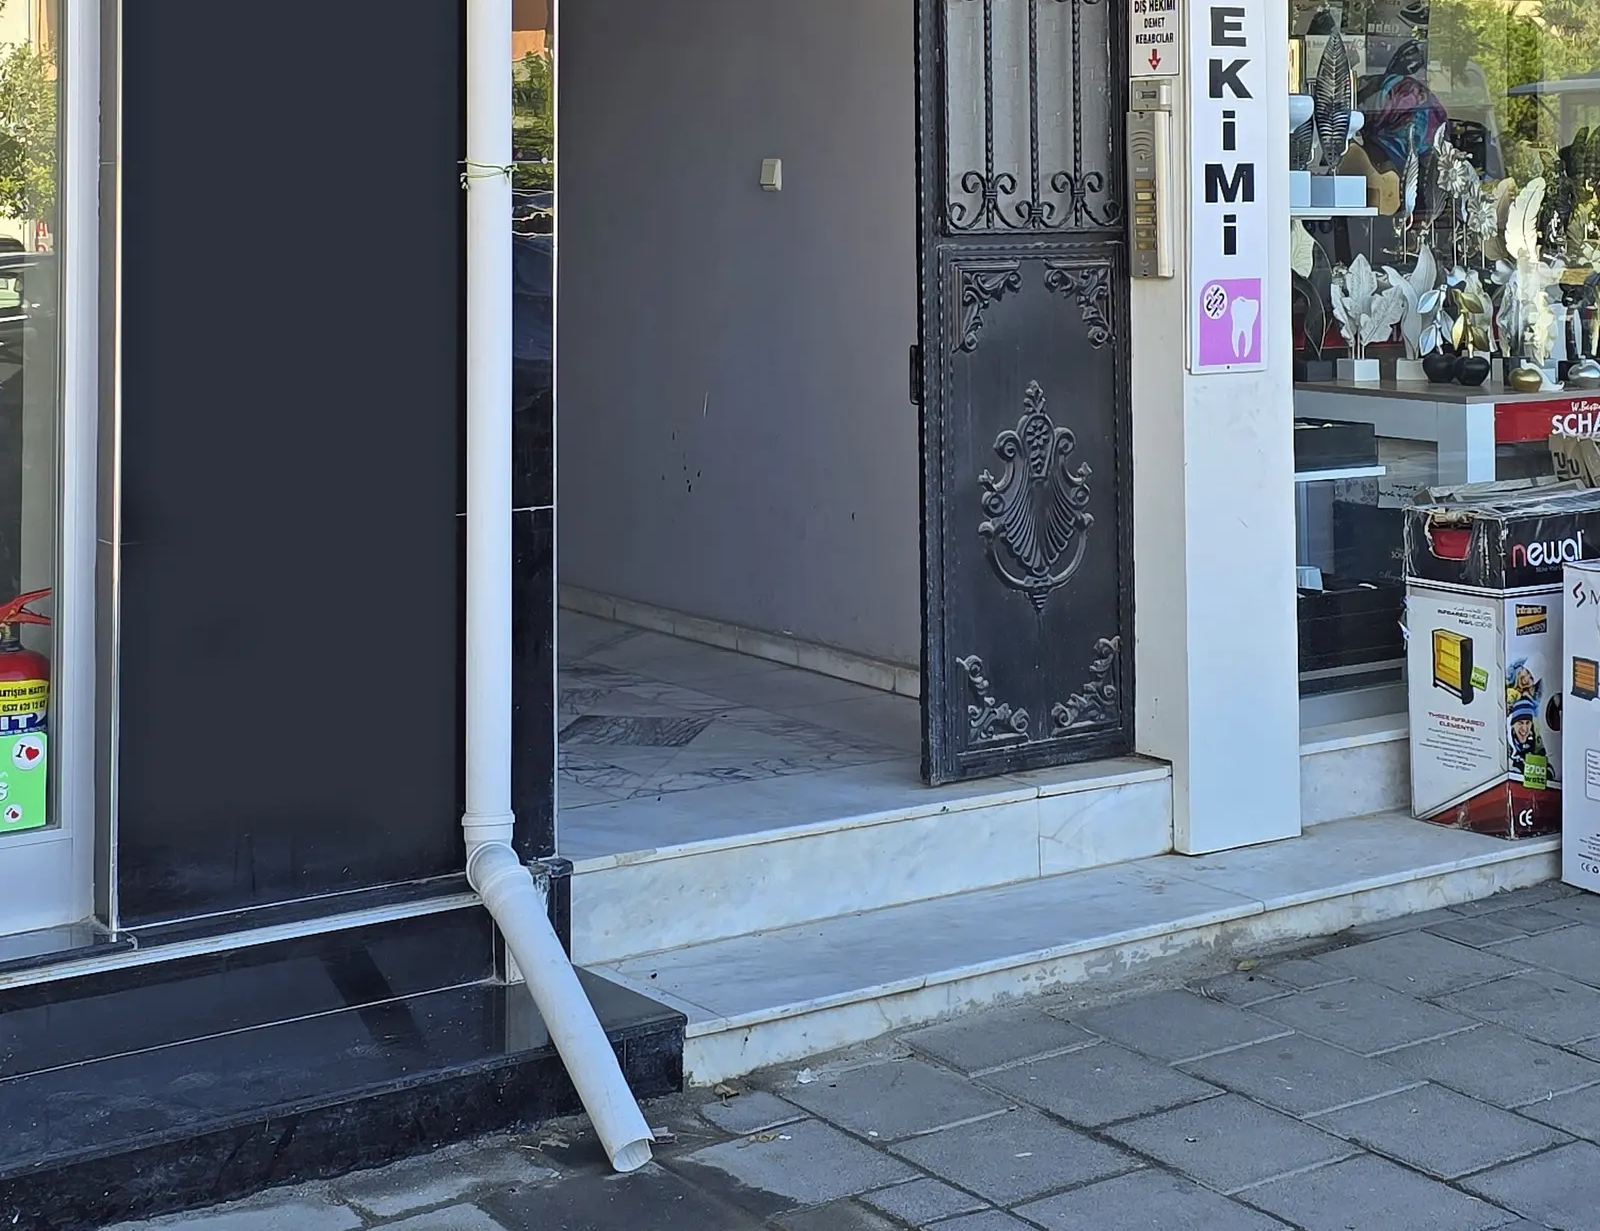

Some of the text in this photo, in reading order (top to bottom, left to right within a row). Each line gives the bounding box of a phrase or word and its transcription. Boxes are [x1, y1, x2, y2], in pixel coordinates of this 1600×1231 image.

[1144, 17, 1165, 29] DEMET
[1135, 32, 1174, 45] KEBABCILAR
[1512, 530, 1583, 568] newal
